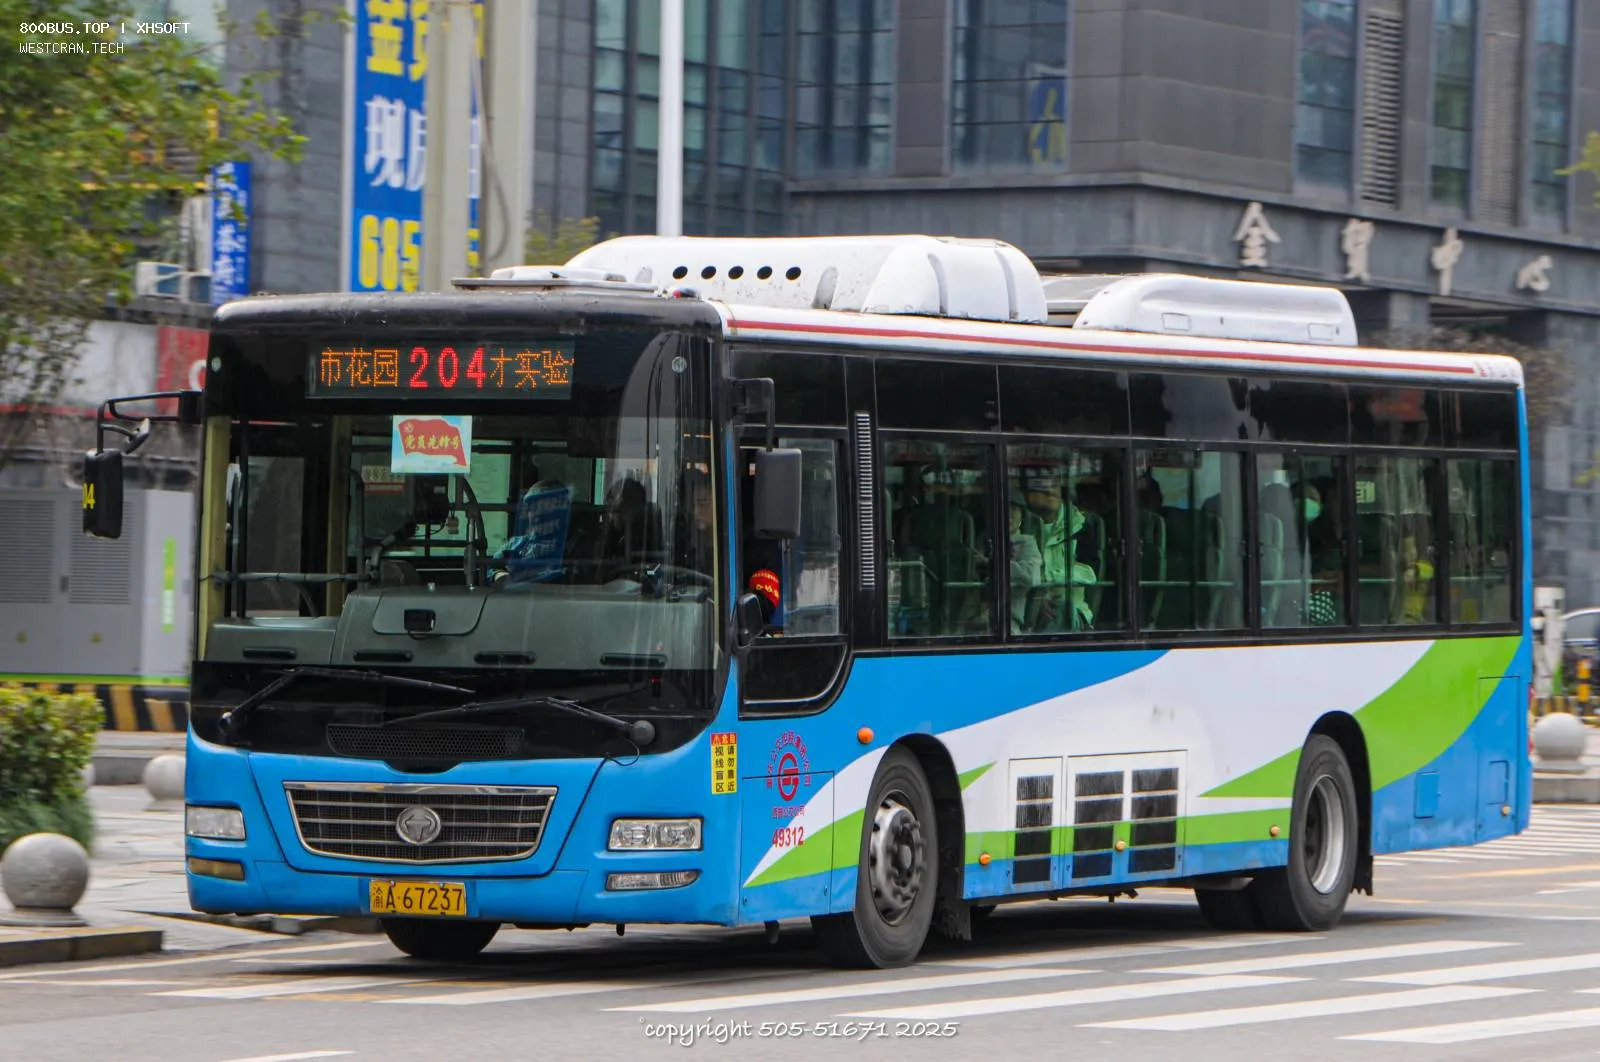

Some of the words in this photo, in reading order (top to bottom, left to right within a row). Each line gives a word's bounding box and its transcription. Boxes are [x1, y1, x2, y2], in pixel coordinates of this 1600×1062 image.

[320, 346, 399, 387] 市花园
[408, 346, 487, 389] 204
[714, 744, 725, 793] 视线盲区
[773, 827, 804, 848] 49312
